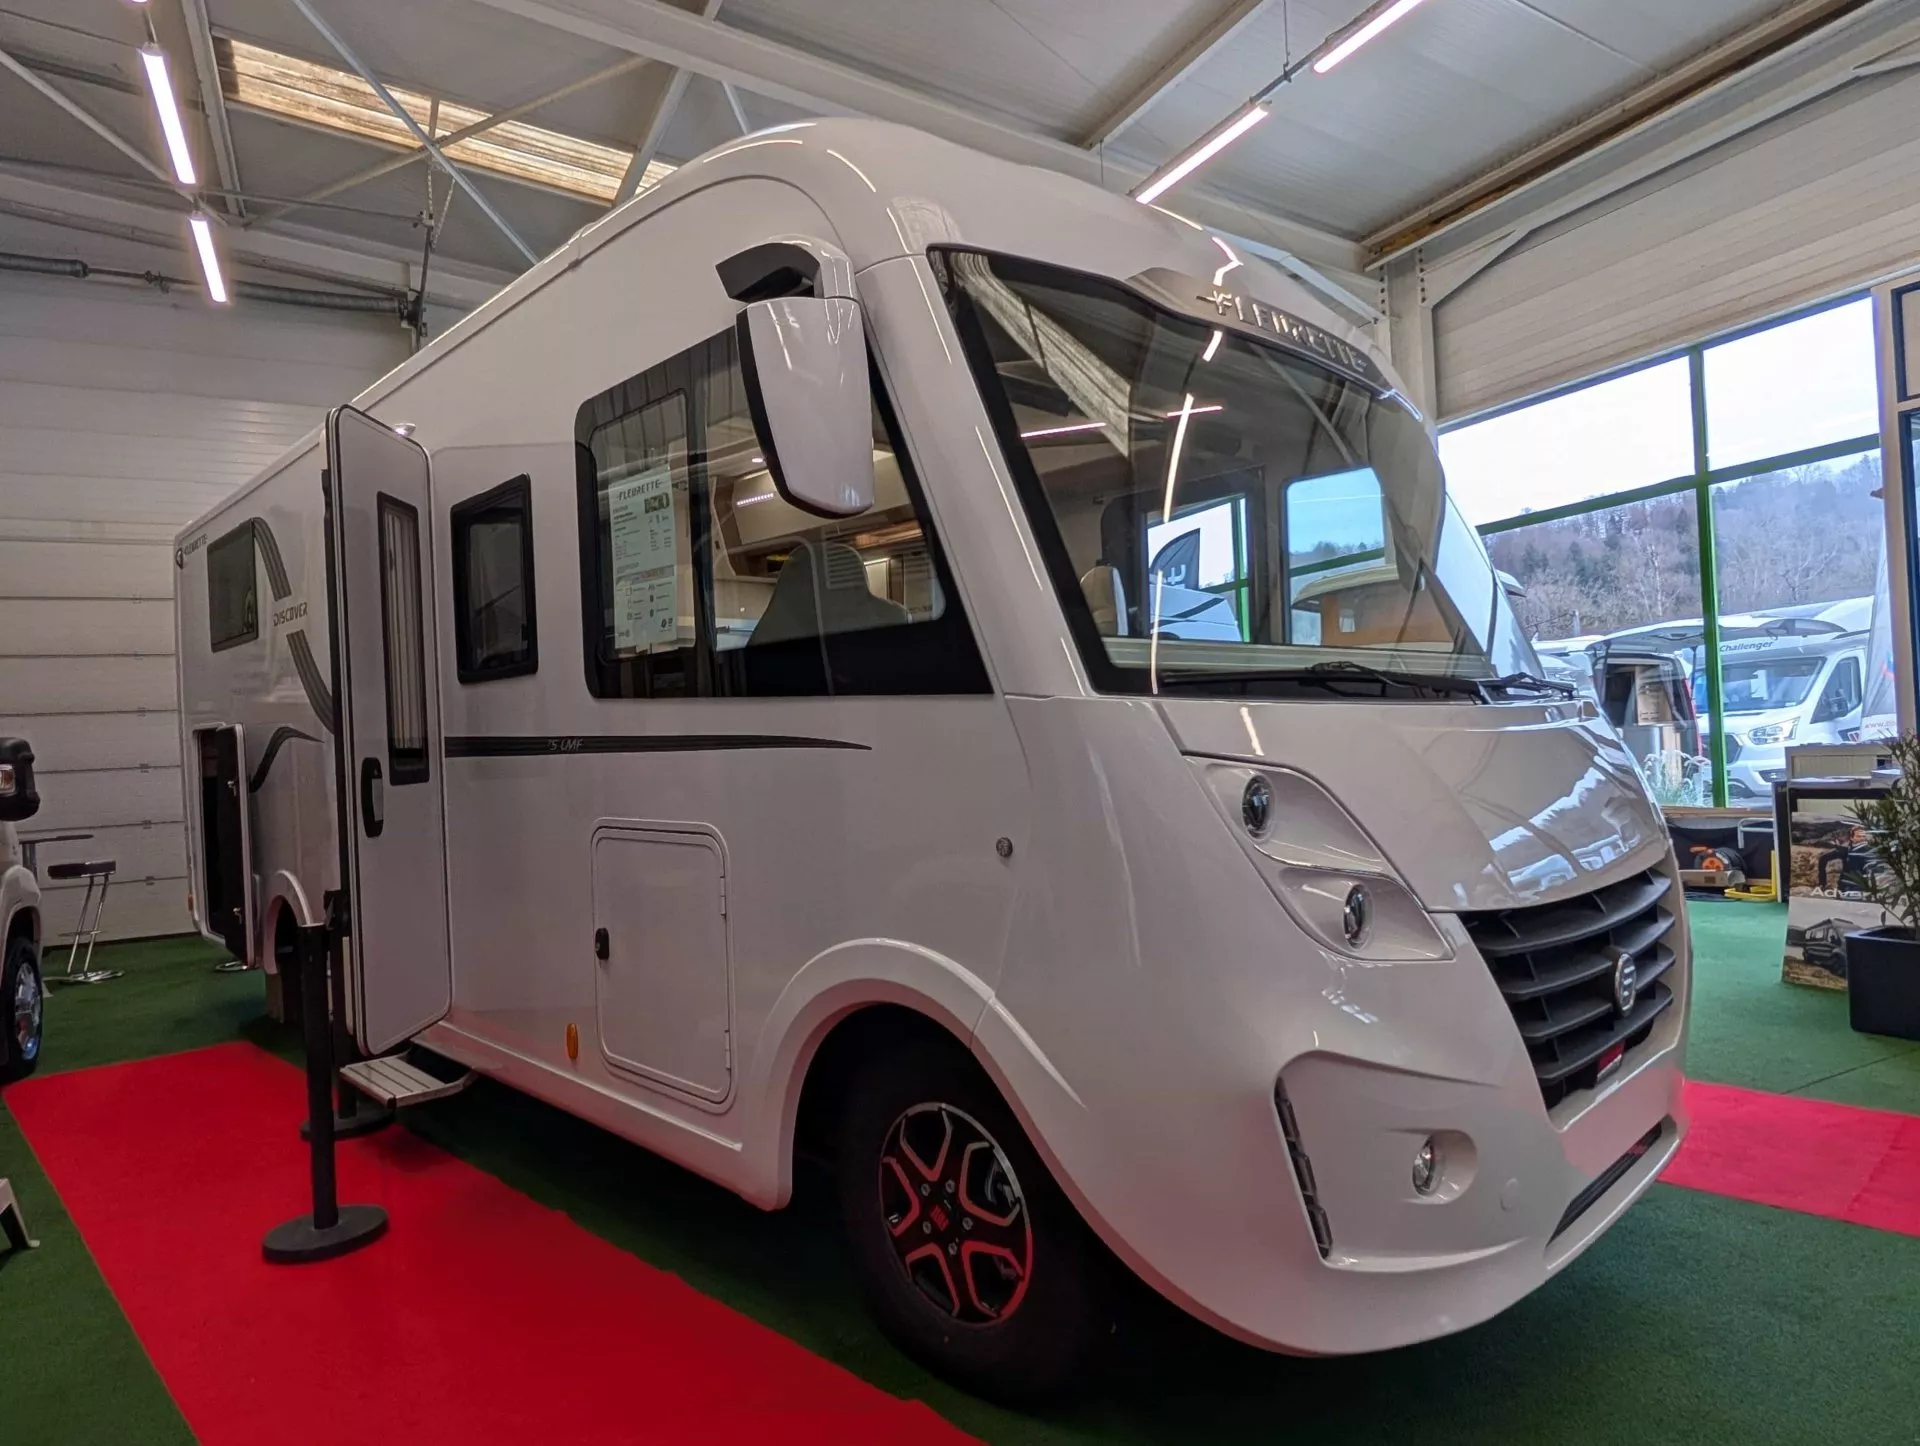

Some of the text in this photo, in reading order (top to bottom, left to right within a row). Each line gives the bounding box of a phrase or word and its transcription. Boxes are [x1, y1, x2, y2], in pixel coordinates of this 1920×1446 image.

[617, 478, 662, 501] FLEURETTE
[273, 601, 308, 627] DISCOVER
[1720, 641, 1775, 652] Challenger
